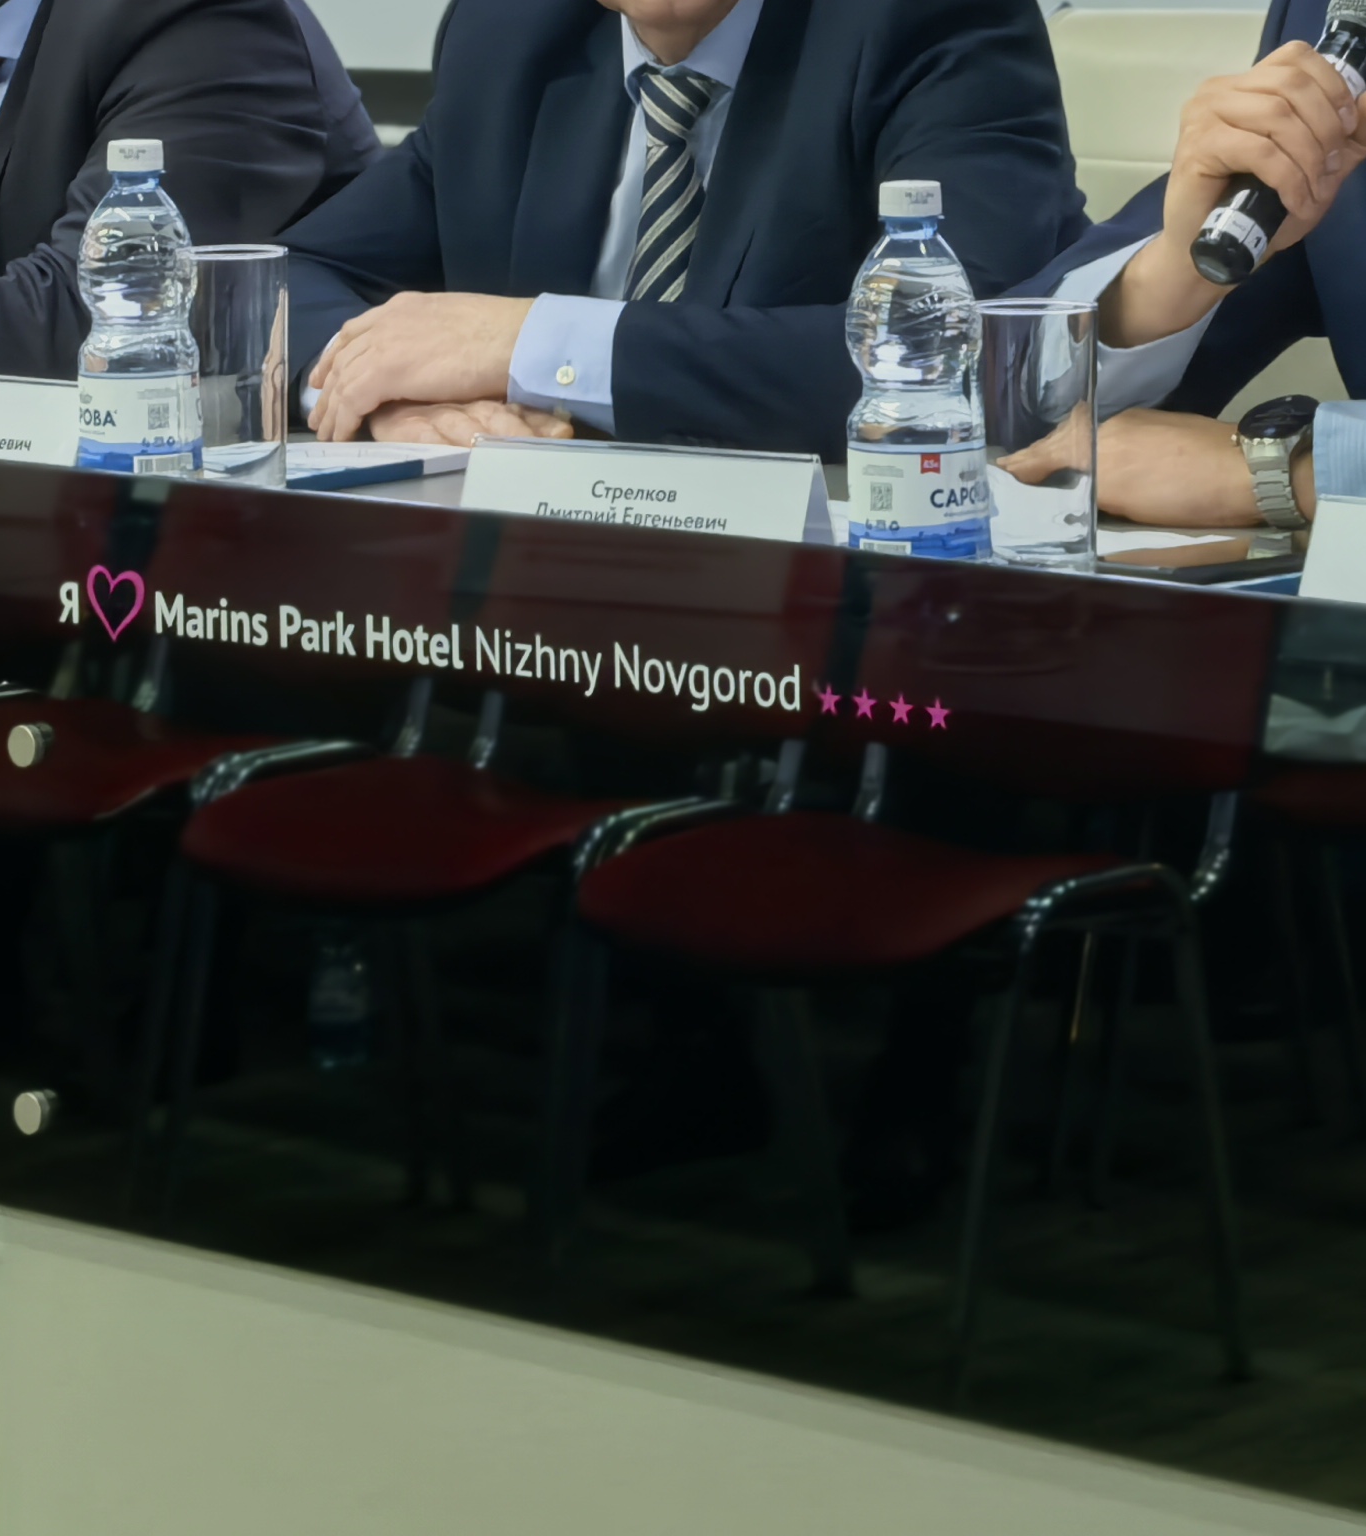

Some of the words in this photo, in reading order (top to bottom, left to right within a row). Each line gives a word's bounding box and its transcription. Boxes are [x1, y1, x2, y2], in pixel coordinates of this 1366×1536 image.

[591, 479, 678, 504] Стрелков
[58, 581, 80, 625] Я
[154, 590, 269, 647] Marins
[278, 604, 357, 657] Park
[365, 613, 465, 670] Hotel
[474, 625, 603, 698] Nizhny
[613, 641, 802, 712] Novgorod
